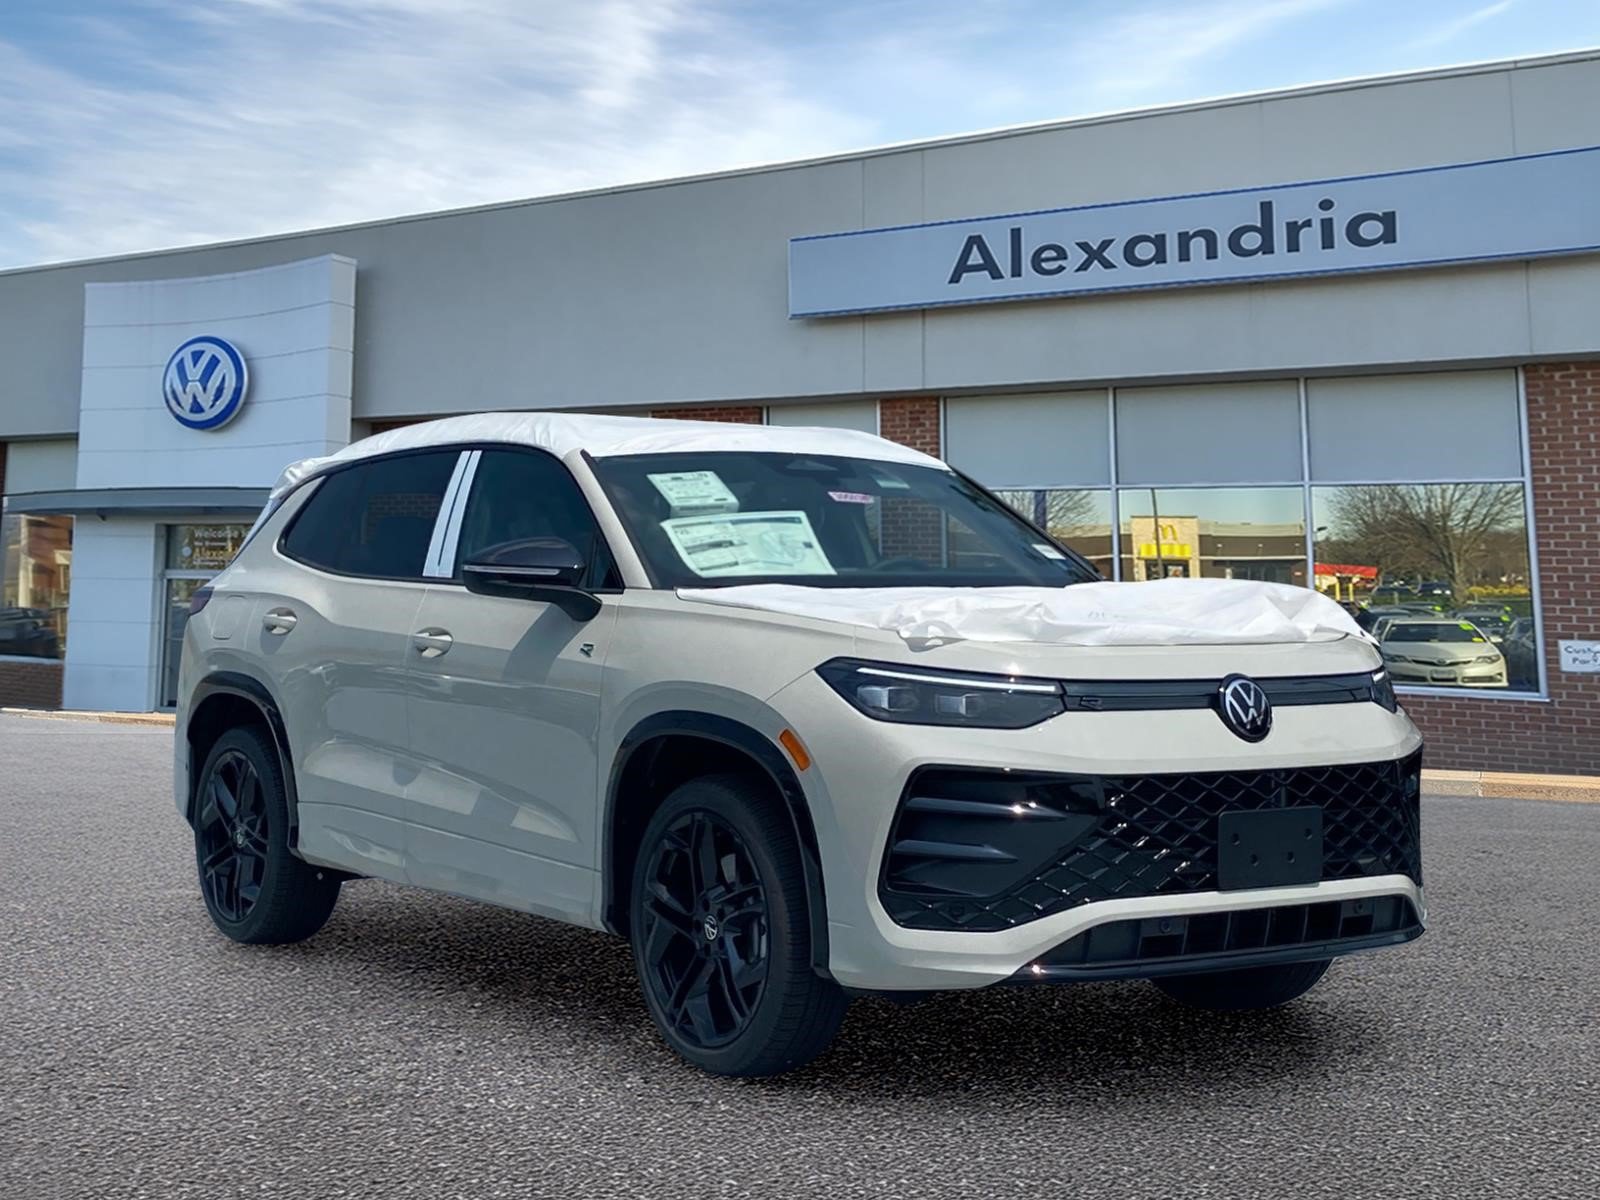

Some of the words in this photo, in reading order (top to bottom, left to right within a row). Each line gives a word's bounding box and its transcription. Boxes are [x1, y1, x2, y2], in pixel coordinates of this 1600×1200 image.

[948, 198, 1397, 284] Alexandria
[164, 339, 238, 423] VW
[1224, 677, 1268, 735] VW
